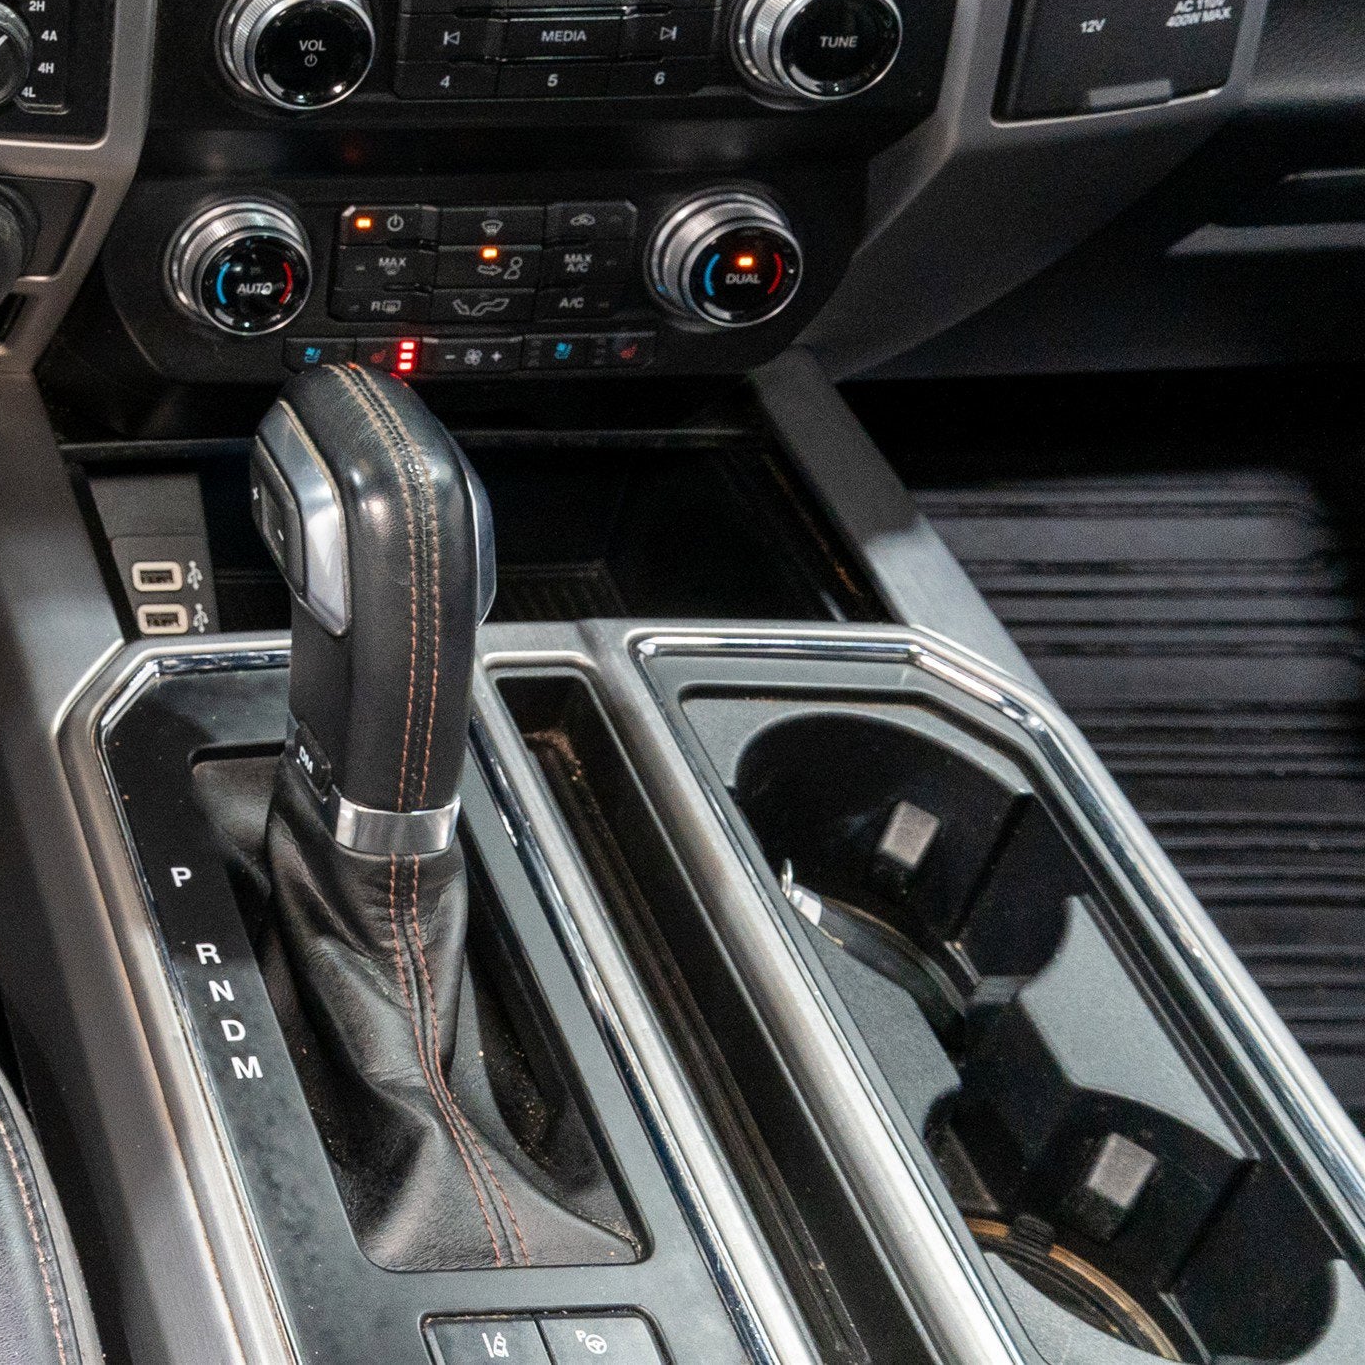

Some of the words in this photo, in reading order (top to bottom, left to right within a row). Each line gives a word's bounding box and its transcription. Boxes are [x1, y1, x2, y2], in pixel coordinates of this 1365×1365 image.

[29, 0, 45, 12] 2H
[1173, 0, 1194, 14] AC
[1081, 19, 1106, 34] 12V
[41, 30, 58, 42] 4A
[541, 30, 587, 43] MEDIA
[820, 35, 858, 49] TUNE
[298, 39, 327, 53] VOL
[38, 63, 54, 75] 4H
[440, 75, 450, 88] 4
[547, 73, 558, 87] 5
[654, 71, 665, 85] 6
[21, 86, 36, 99] 4L
[379, 257, 406, 268] MAX
[564, 253, 592, 264] MAX
[566, 262, 588, 273] A/C
[725, 273, 761, 285] DUAL
[236, 281, 273, 295] AUTO
[559, 297, 585, 309] A/C
[171, 866, 192, 887] P
[196, 943, 222, 965] R
[208, 979, 236, 1001] N
[221, 1020, 247, 1041] D
[231, 1057, 263, 1079] M
